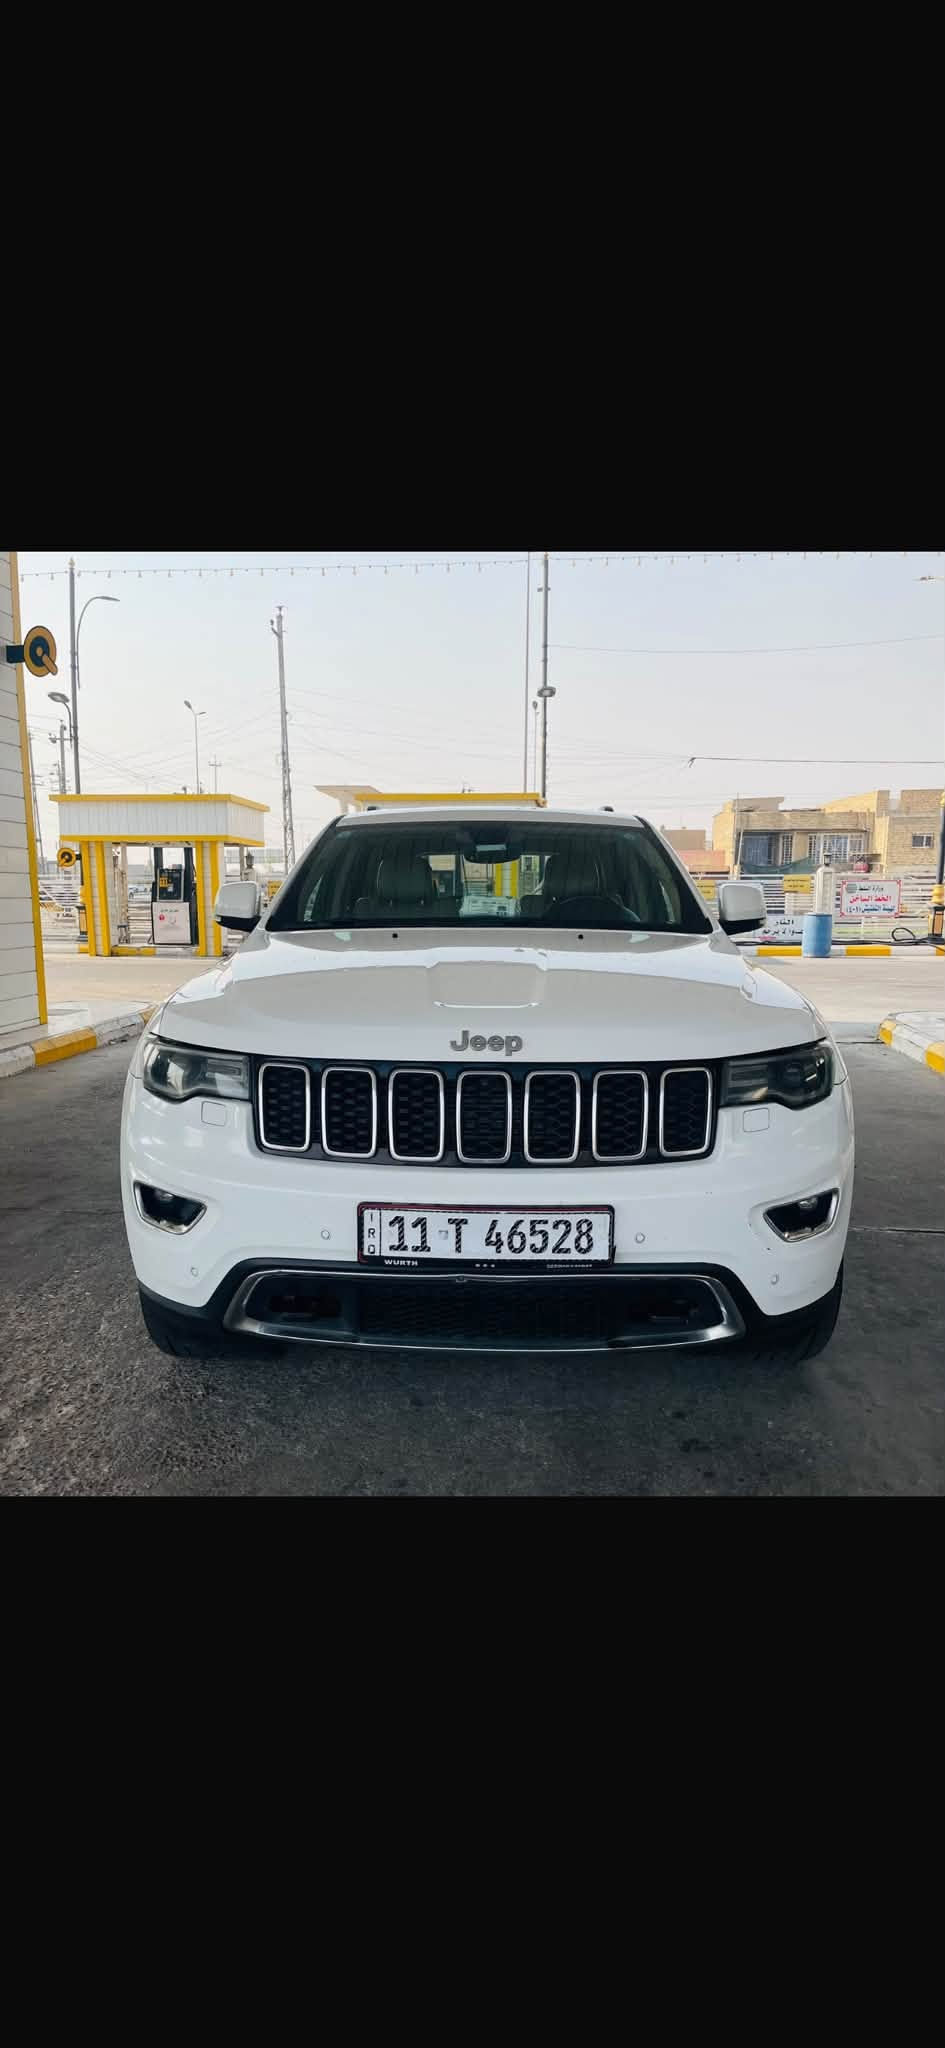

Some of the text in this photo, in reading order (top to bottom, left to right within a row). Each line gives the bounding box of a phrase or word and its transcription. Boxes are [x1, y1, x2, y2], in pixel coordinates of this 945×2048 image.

[450, 1030, 523, 1056] Jeep
[388, 1215, 594, 1254] 11 T 46528
